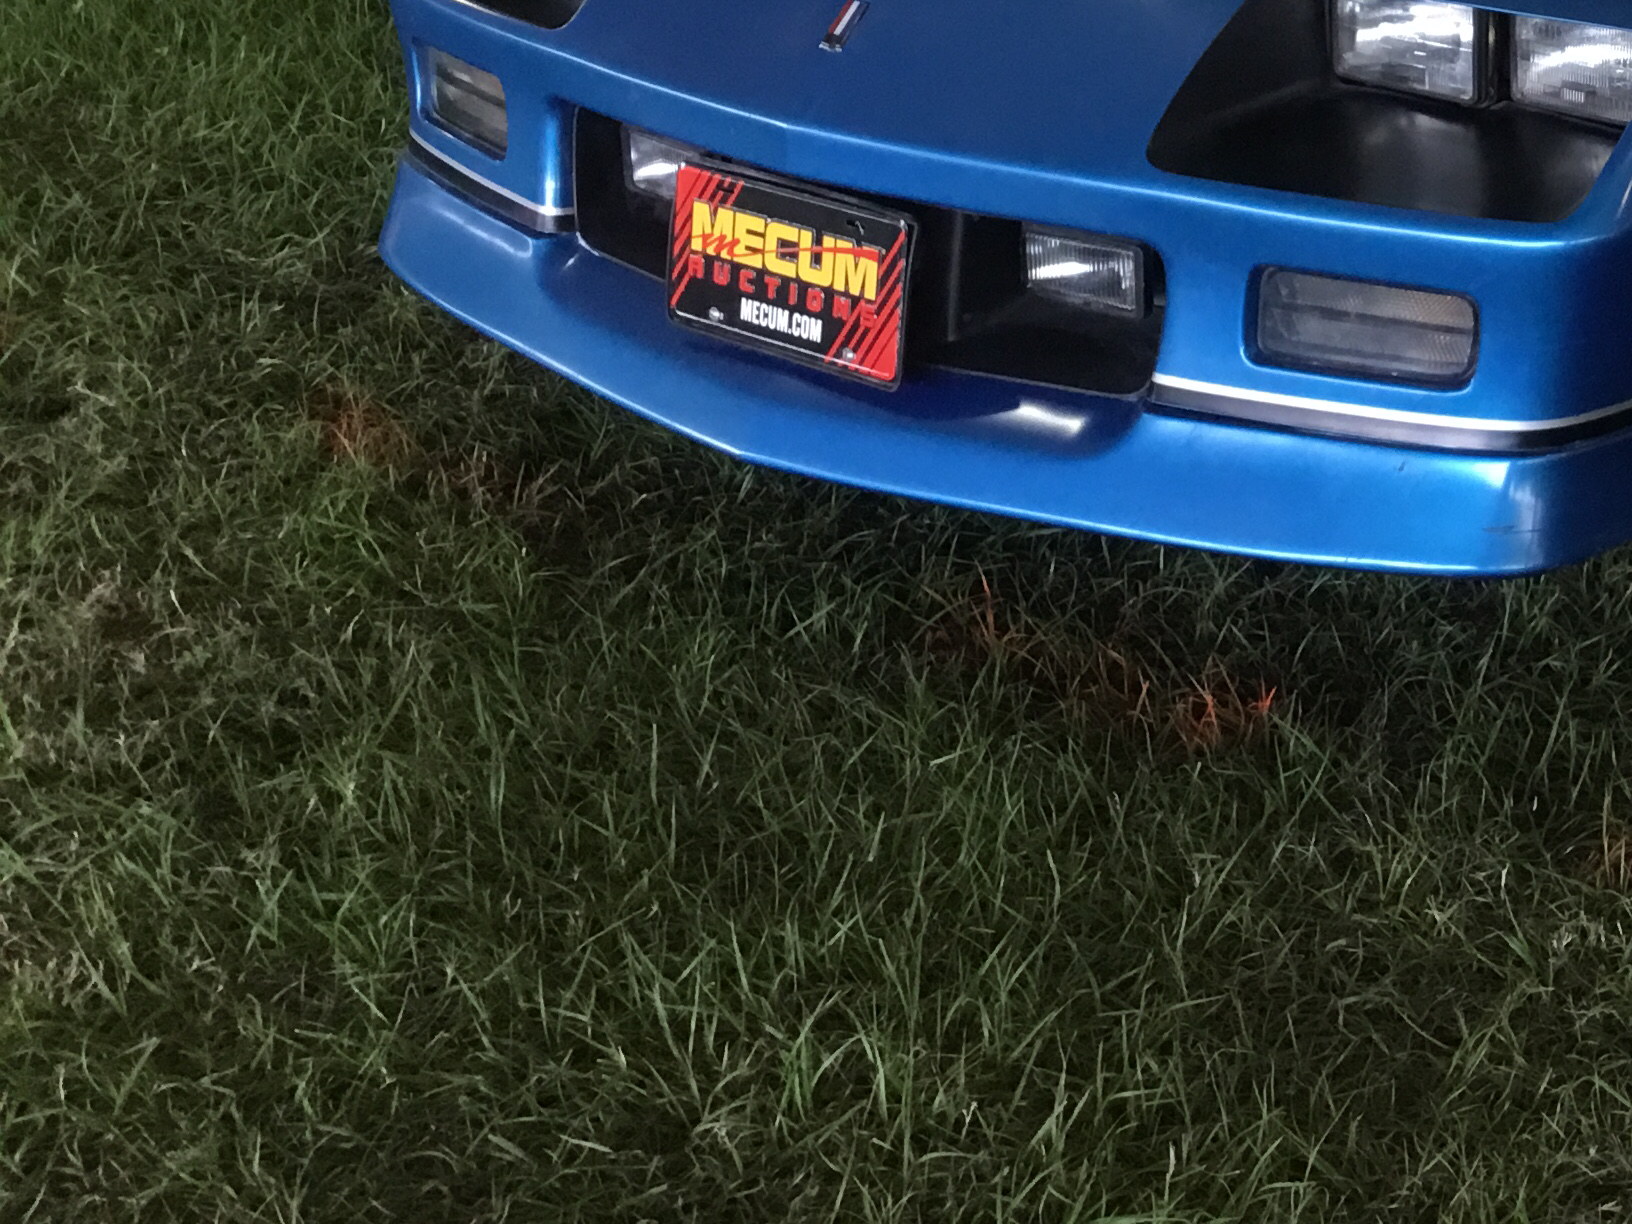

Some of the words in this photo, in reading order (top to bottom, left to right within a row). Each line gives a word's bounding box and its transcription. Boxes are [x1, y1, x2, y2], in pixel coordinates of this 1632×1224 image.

[691, 198, 882, 300] MECUM
[689, 254, 877, 328] AUCTIONS
[740, 298, 822, 343] MECUM.COM
